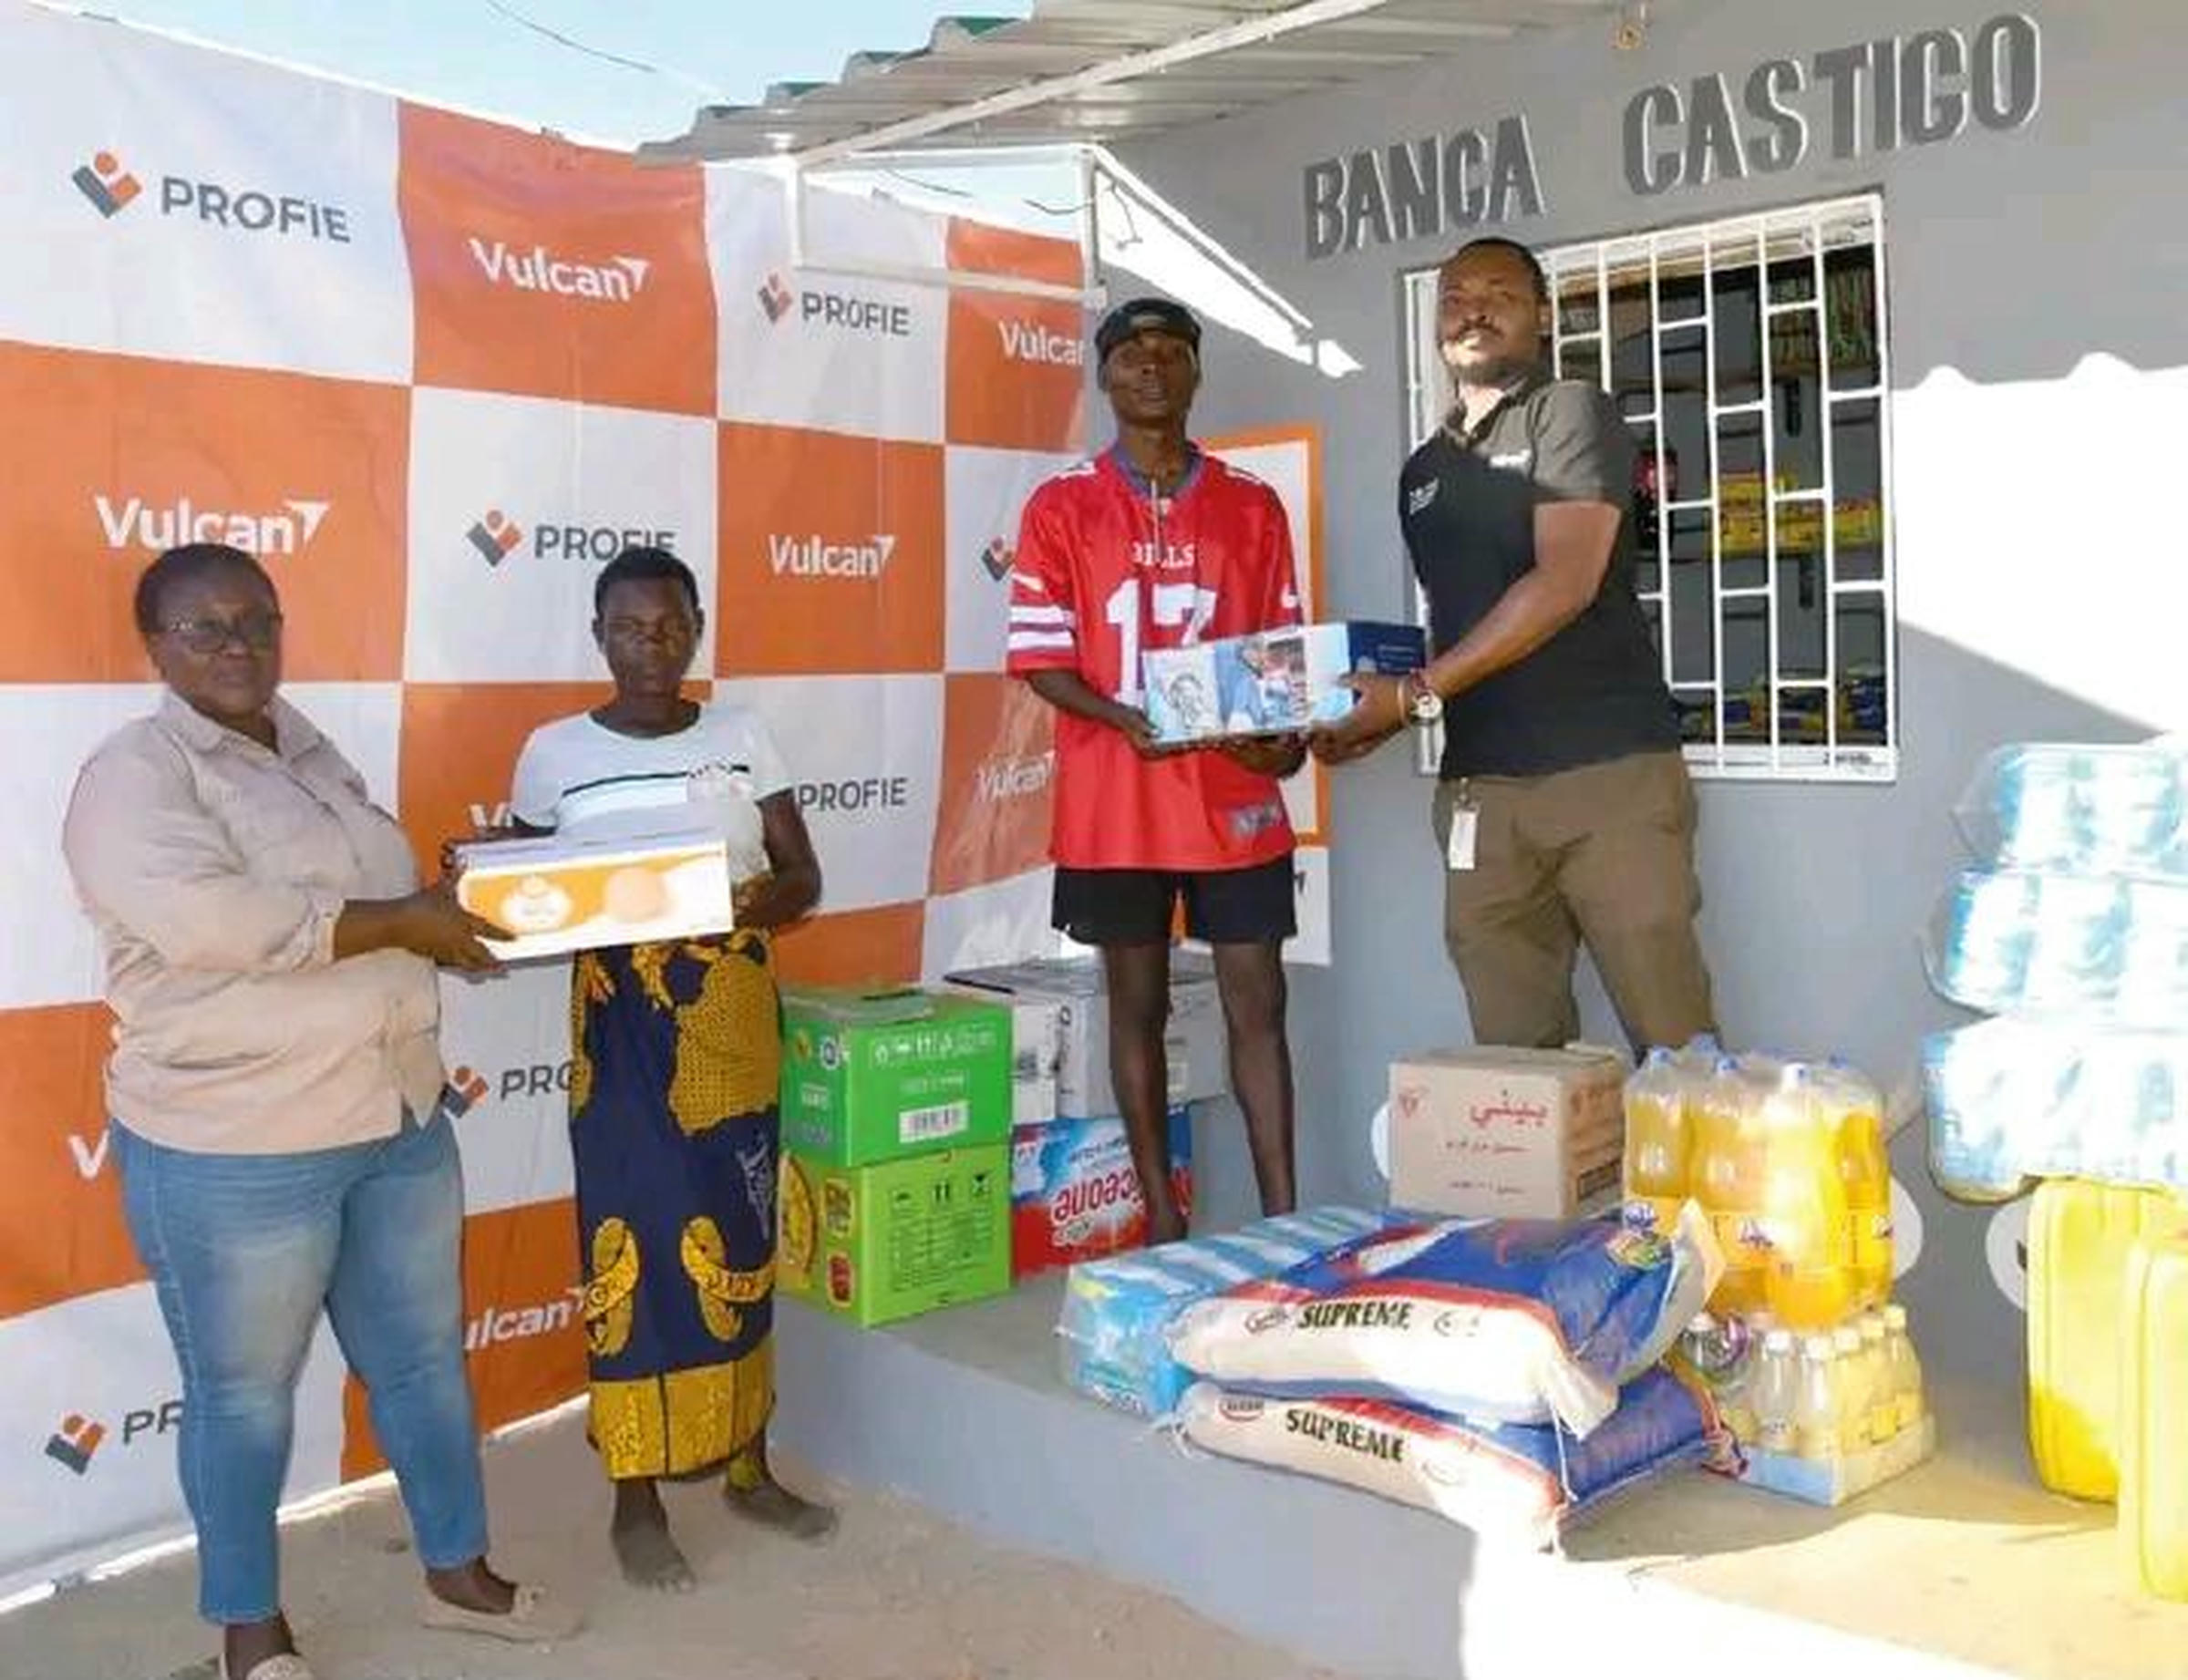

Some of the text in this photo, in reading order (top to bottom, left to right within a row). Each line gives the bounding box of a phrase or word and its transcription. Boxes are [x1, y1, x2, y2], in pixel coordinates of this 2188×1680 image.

[162, 178, 351, 243] PROFIE
[469, 238, 631, 302] Vulcan
[802, 291, 910, 336] PROFIE
[95, 496, 294, 554] Vulcan
[768, 535, 880, 577] Vulcan
[1107, 579, 1217, 708] 17
[799, 777, 908, 812] PROFIE
[1297, 1301, 1413, 1331] SUPREME
[1285, 1408, 1405, 1462] SUPREME
